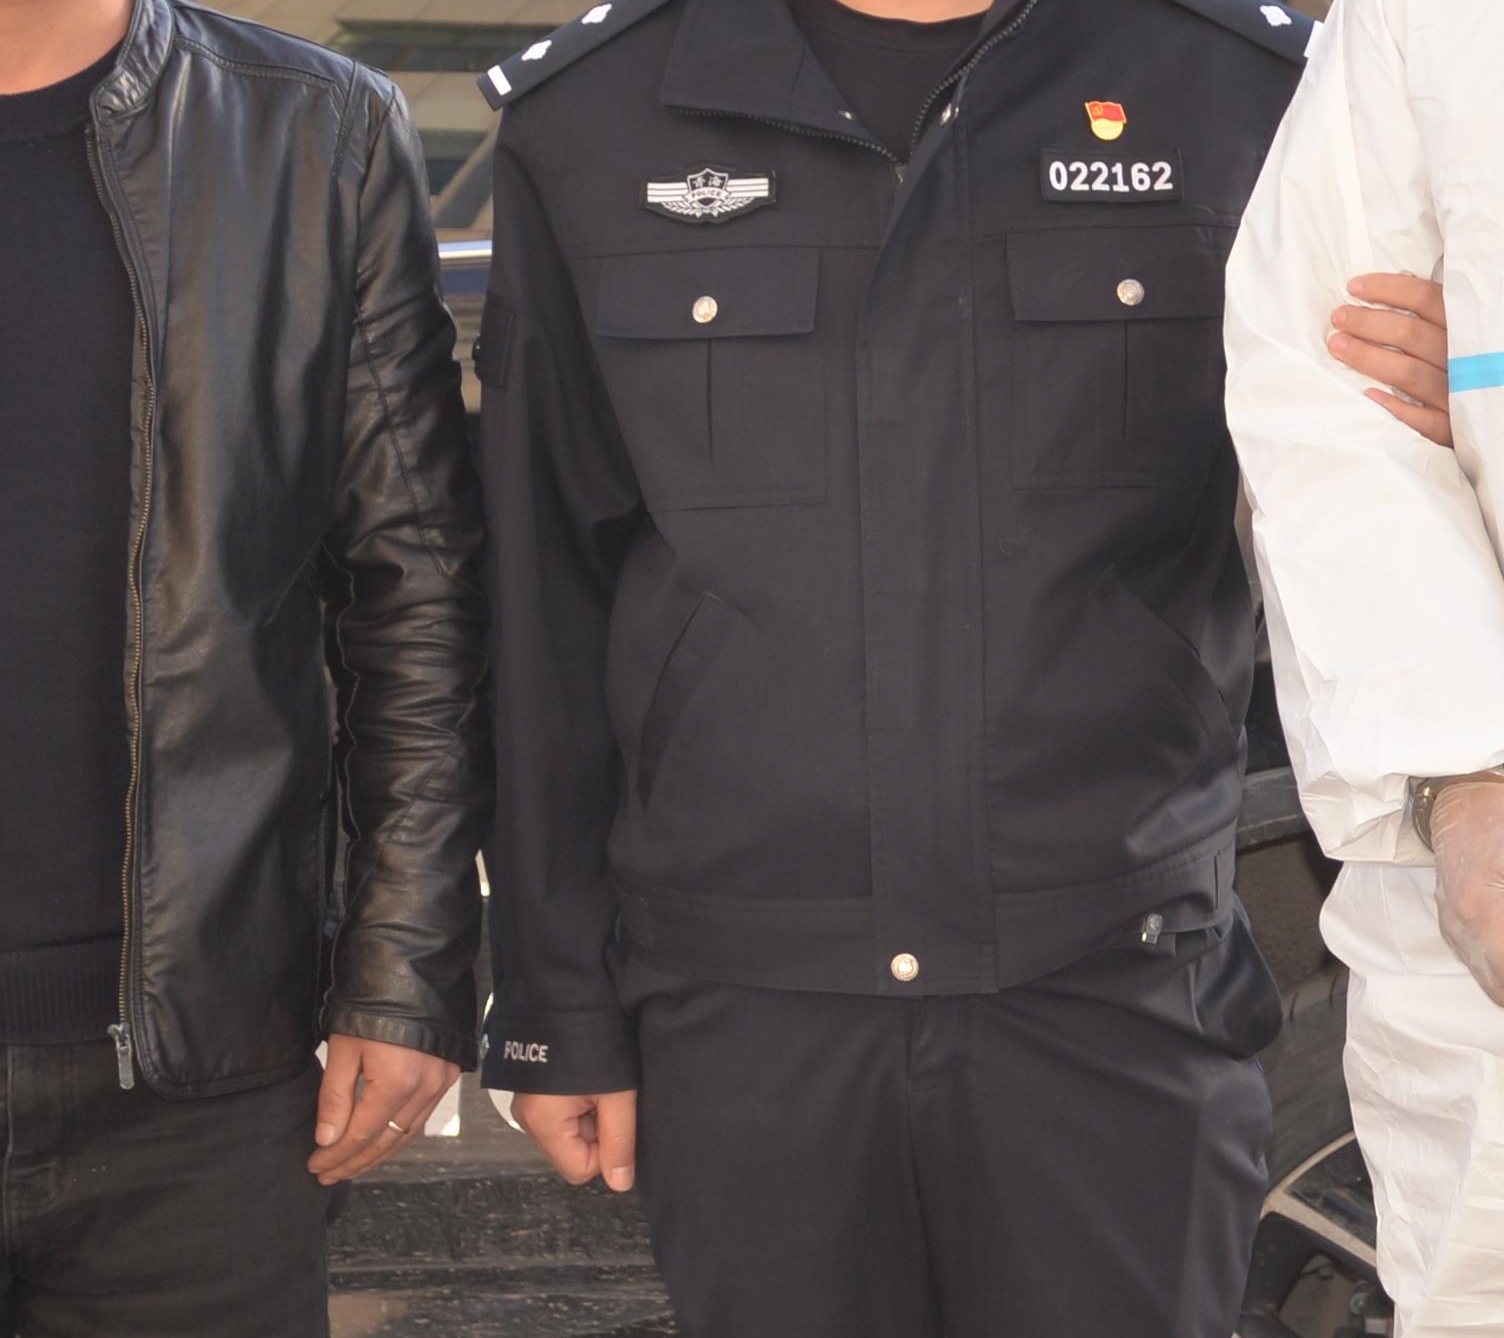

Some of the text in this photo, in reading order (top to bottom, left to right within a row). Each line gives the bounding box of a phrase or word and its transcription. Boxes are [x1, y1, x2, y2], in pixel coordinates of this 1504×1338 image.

[1049, 161, 1174, 193] 022162
[691, 189, 722, 198] POLICE
[503, 1041, 549, 1063] POLICE
